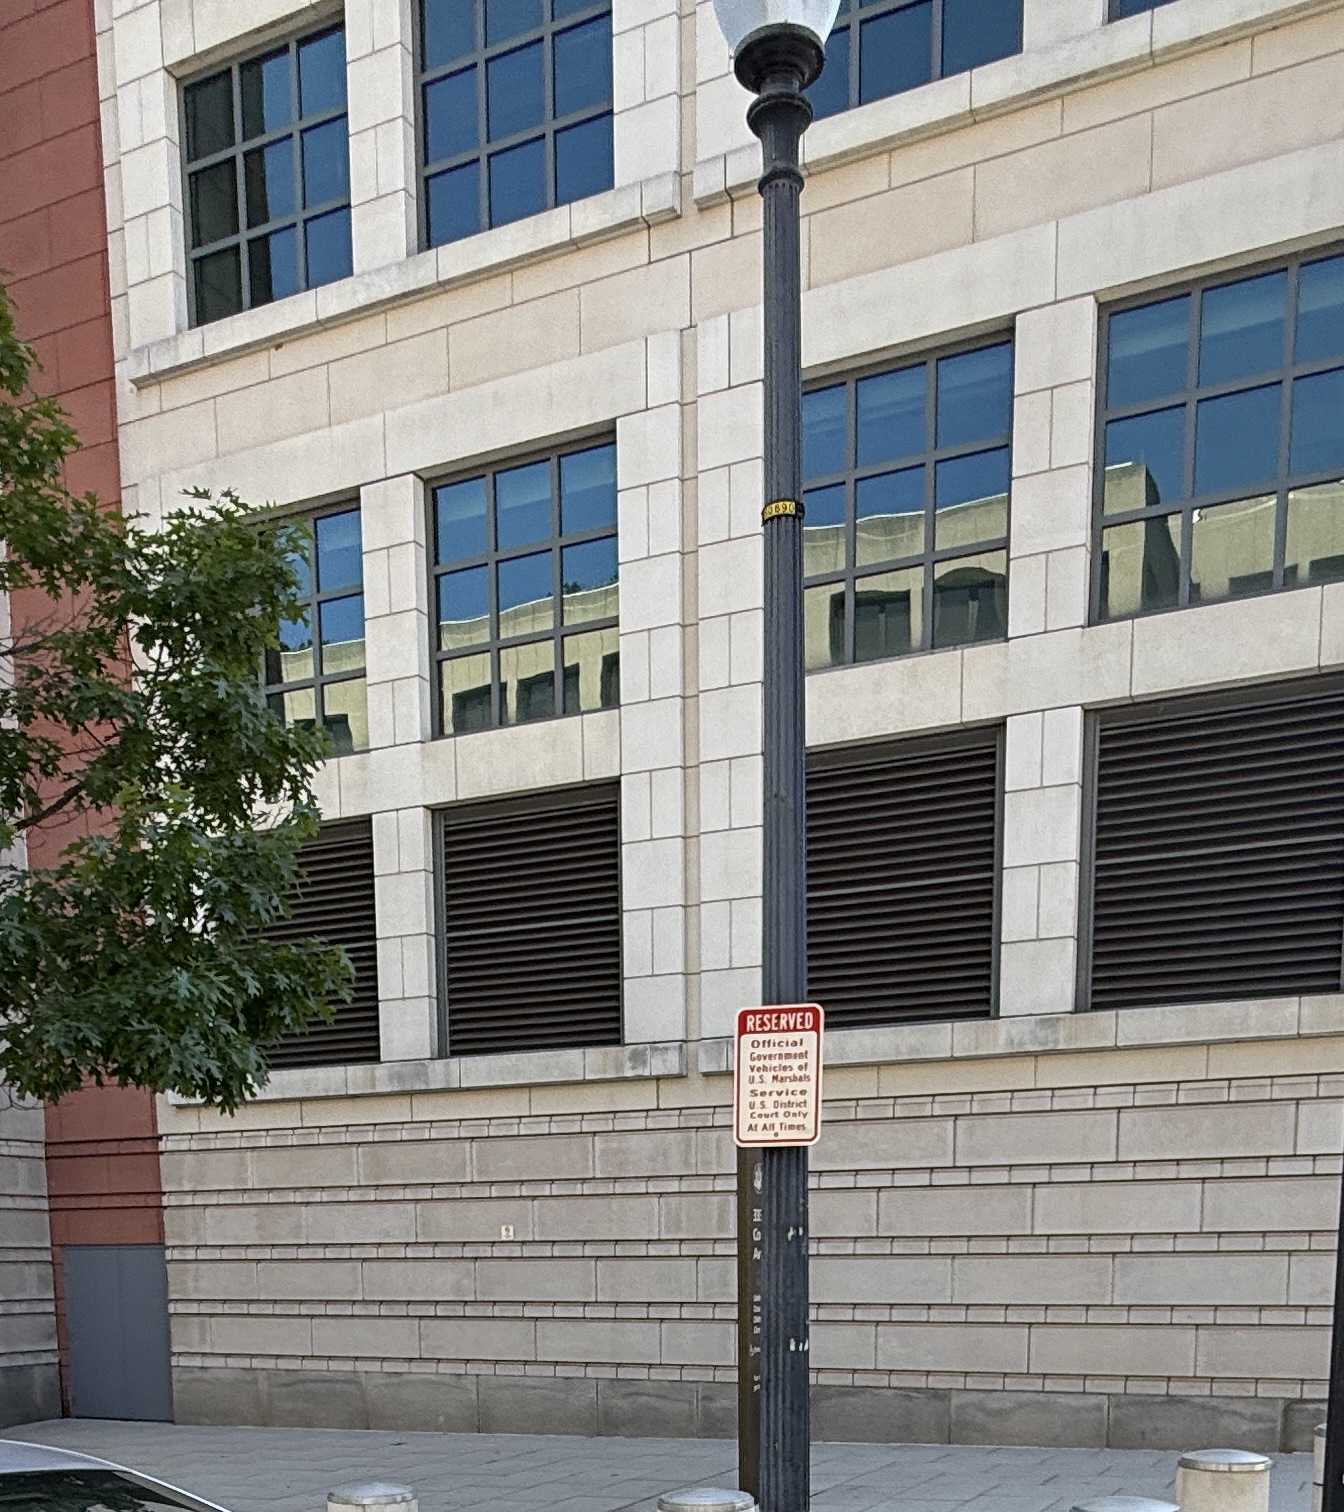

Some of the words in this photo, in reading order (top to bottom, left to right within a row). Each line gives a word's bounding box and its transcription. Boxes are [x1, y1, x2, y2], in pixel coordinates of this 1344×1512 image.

[746, 1012, 813, 1032] RESERVED
[751, 1038, 804, 1049] Official
[749, 1050, 809, 1062] Government
[749, 1064, 794, 1073] Vehicles
[797, 1062, 808, 1072] of
[748, 1075, 767, 1085] U.S.
[771, 1073, 811, 1084] Marshals
[749, 1088, 808, 1098] Service
[748, 1100, 768, 1110] U.S.
[773, 1099, 808, 1110] District
[750, 1110, 779, 1119] Court
[783, 1110, 809, 1120] Only
[747, 1123, 758, 1132] At
[761, 1122, 775, 1132] All
[779, 1122, 806, 1132] Times
